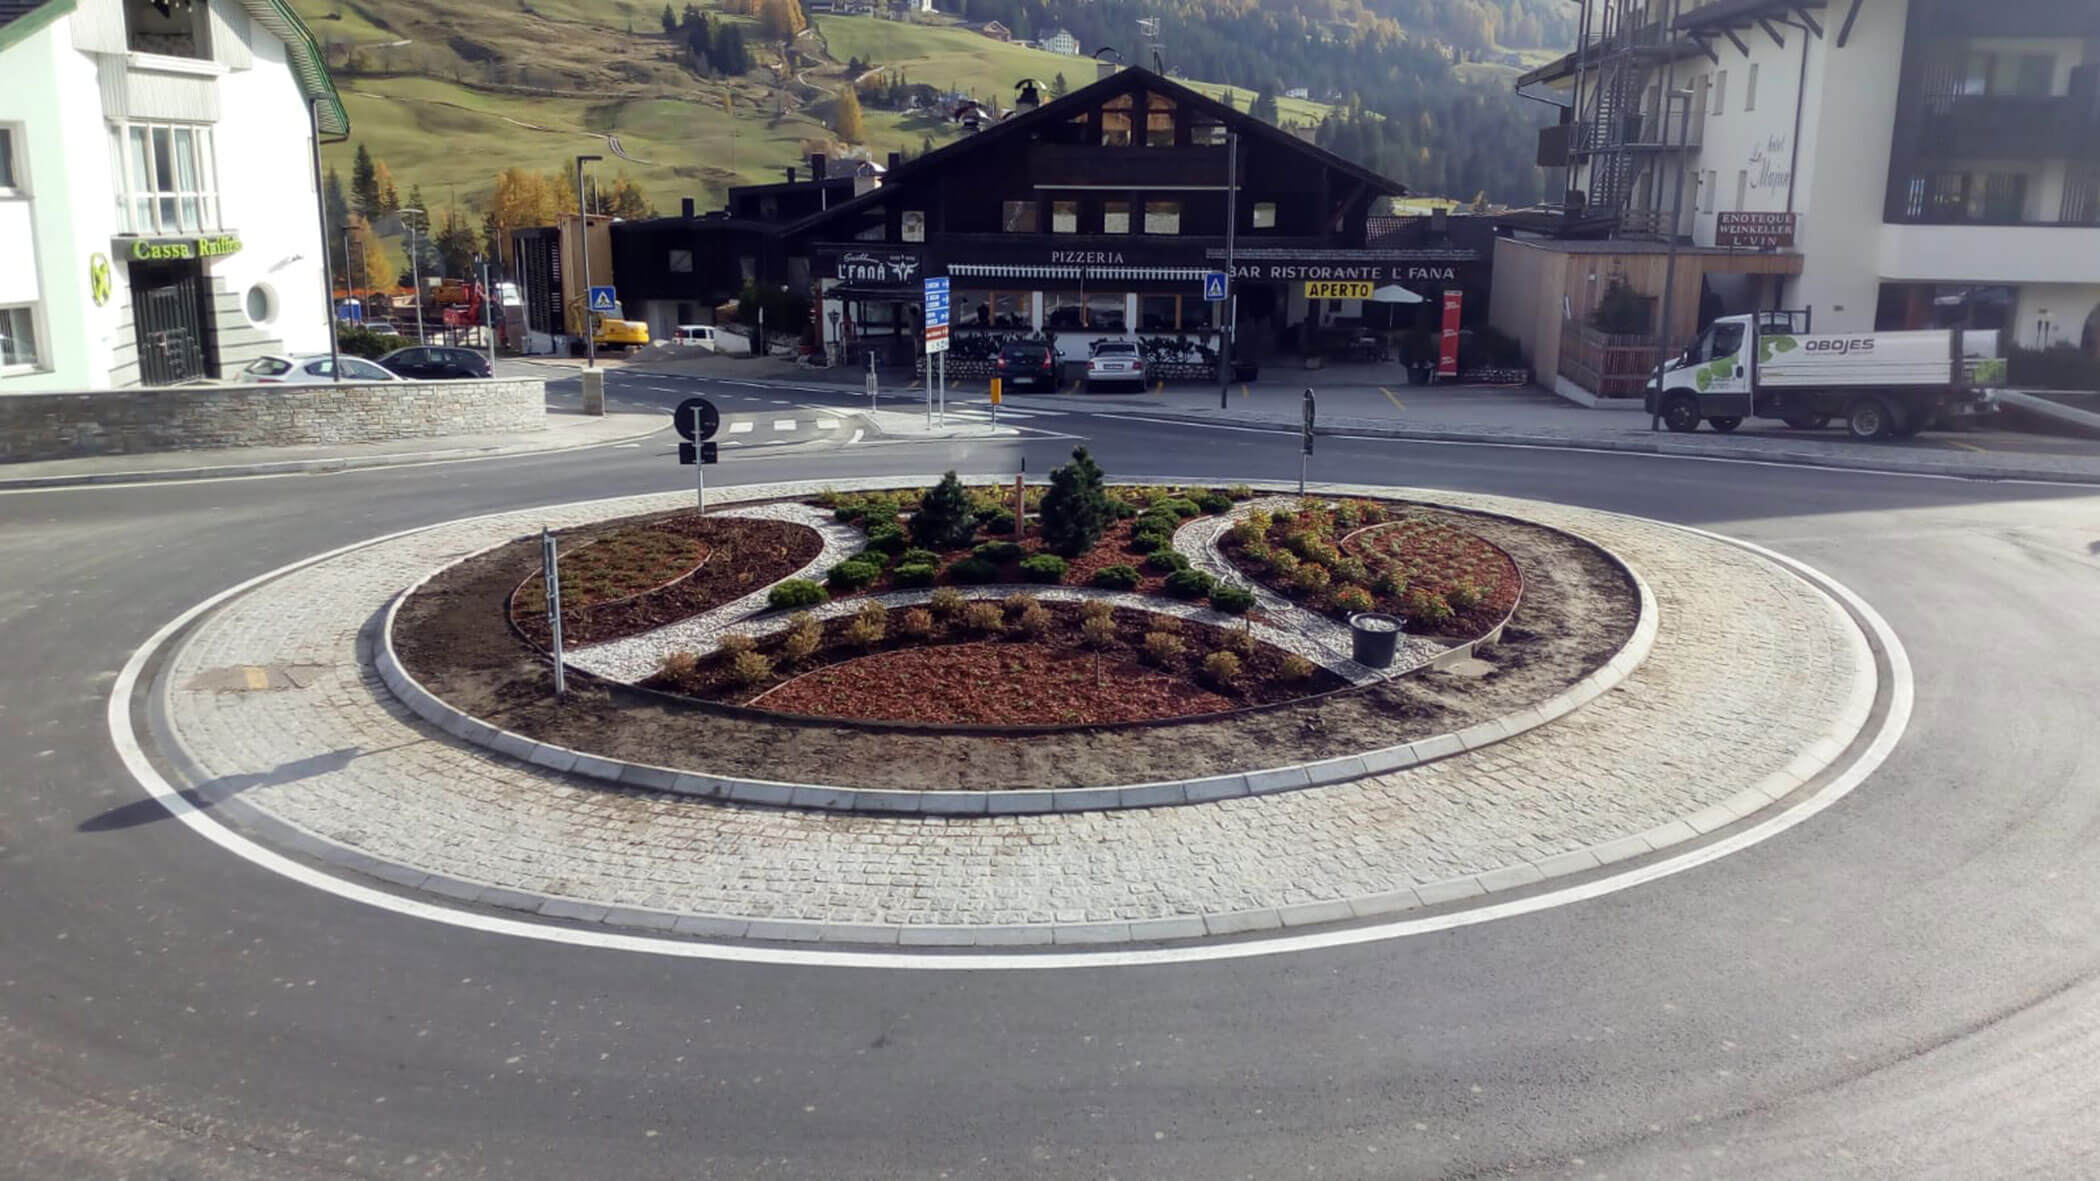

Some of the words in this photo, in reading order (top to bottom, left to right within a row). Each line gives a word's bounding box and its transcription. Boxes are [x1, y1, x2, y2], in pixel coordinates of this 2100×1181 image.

[1722, 214, 1793, 224] ENOTEQUE
[1720, 225, 1793, 235] WEINKELLER
[133, 239, 190, 260] Cassa
[1052, 250, 1124, 264] PIZZERIA
[1230, 265, 1260, 278] BAR
[1271, 265, 1382, 279] RISTORANTE
[1309, 283, 1369, 297] APERTO
[1805, 338, 1875, 354] OBOJES
